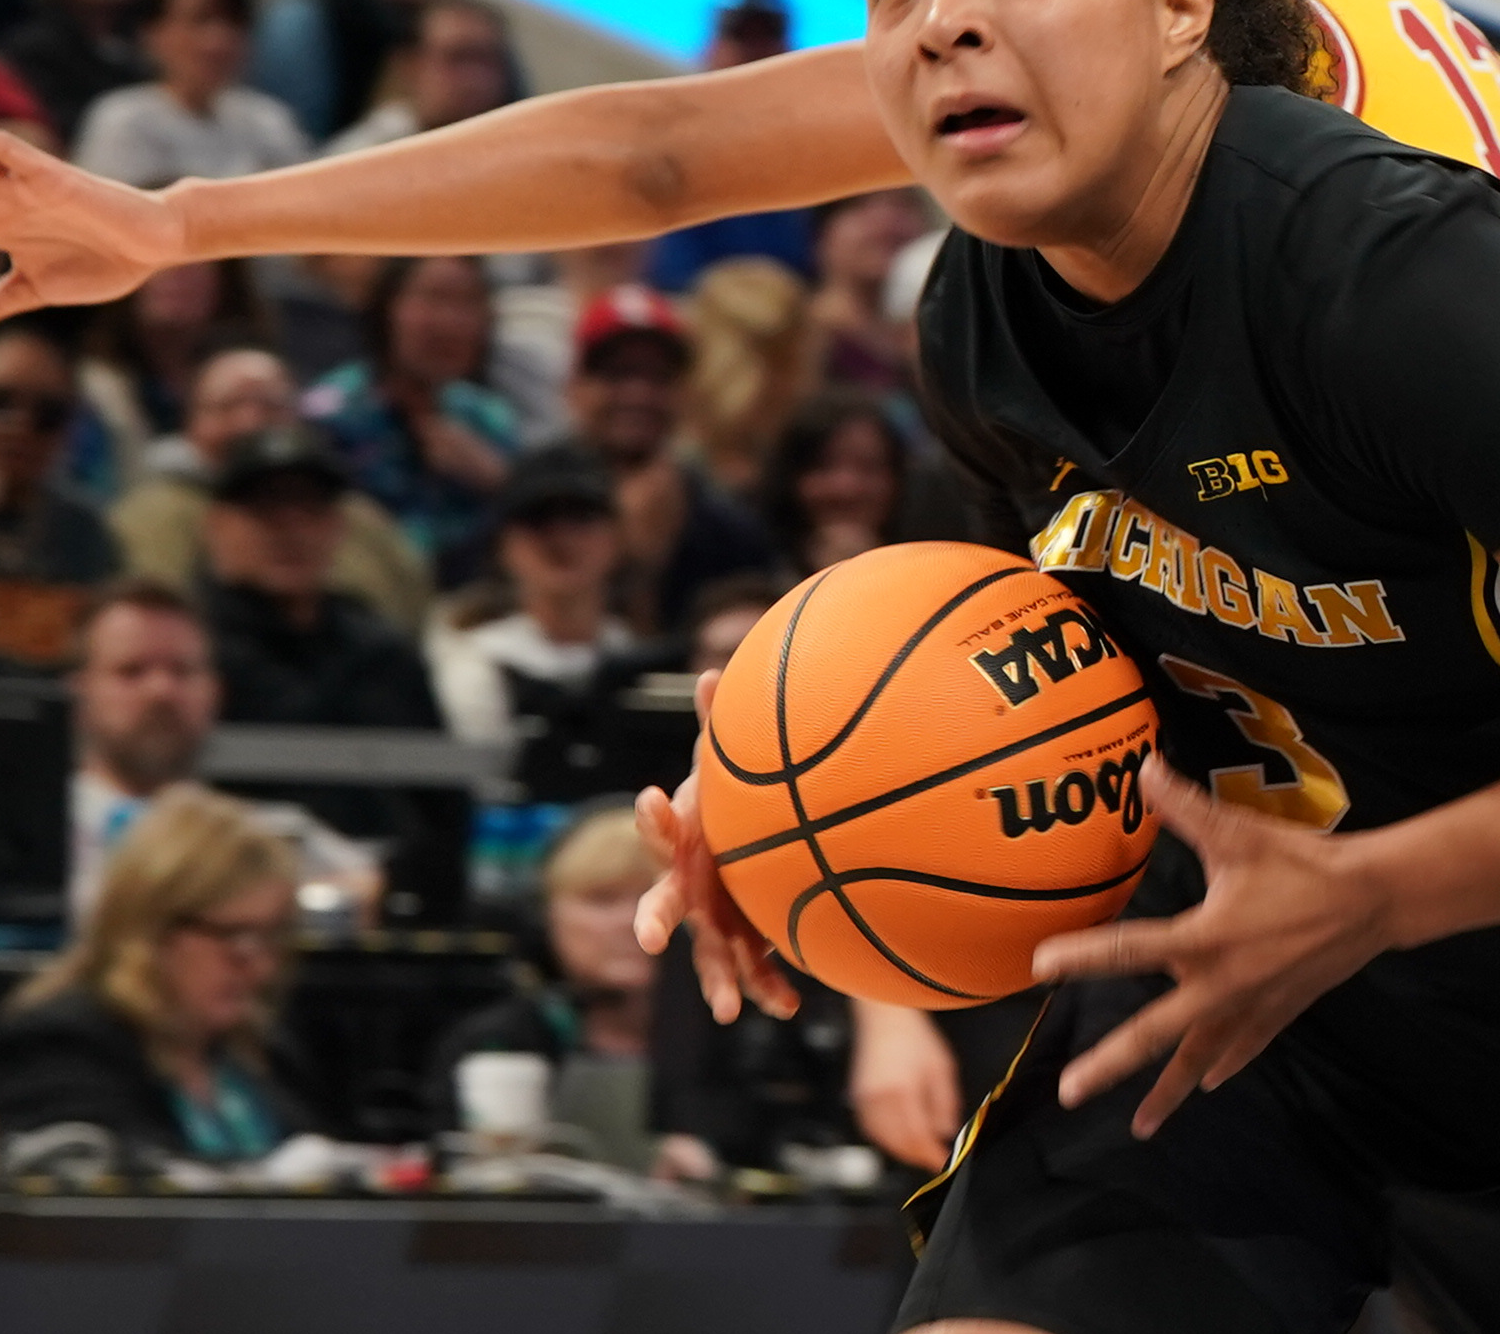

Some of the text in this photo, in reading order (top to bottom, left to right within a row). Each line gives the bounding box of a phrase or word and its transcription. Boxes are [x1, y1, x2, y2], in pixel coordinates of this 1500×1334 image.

[1002, 597, 1048, 623] GAME
[956, 619, 1005, 648] BALL
[1158, 653, 1351, 835] 3
